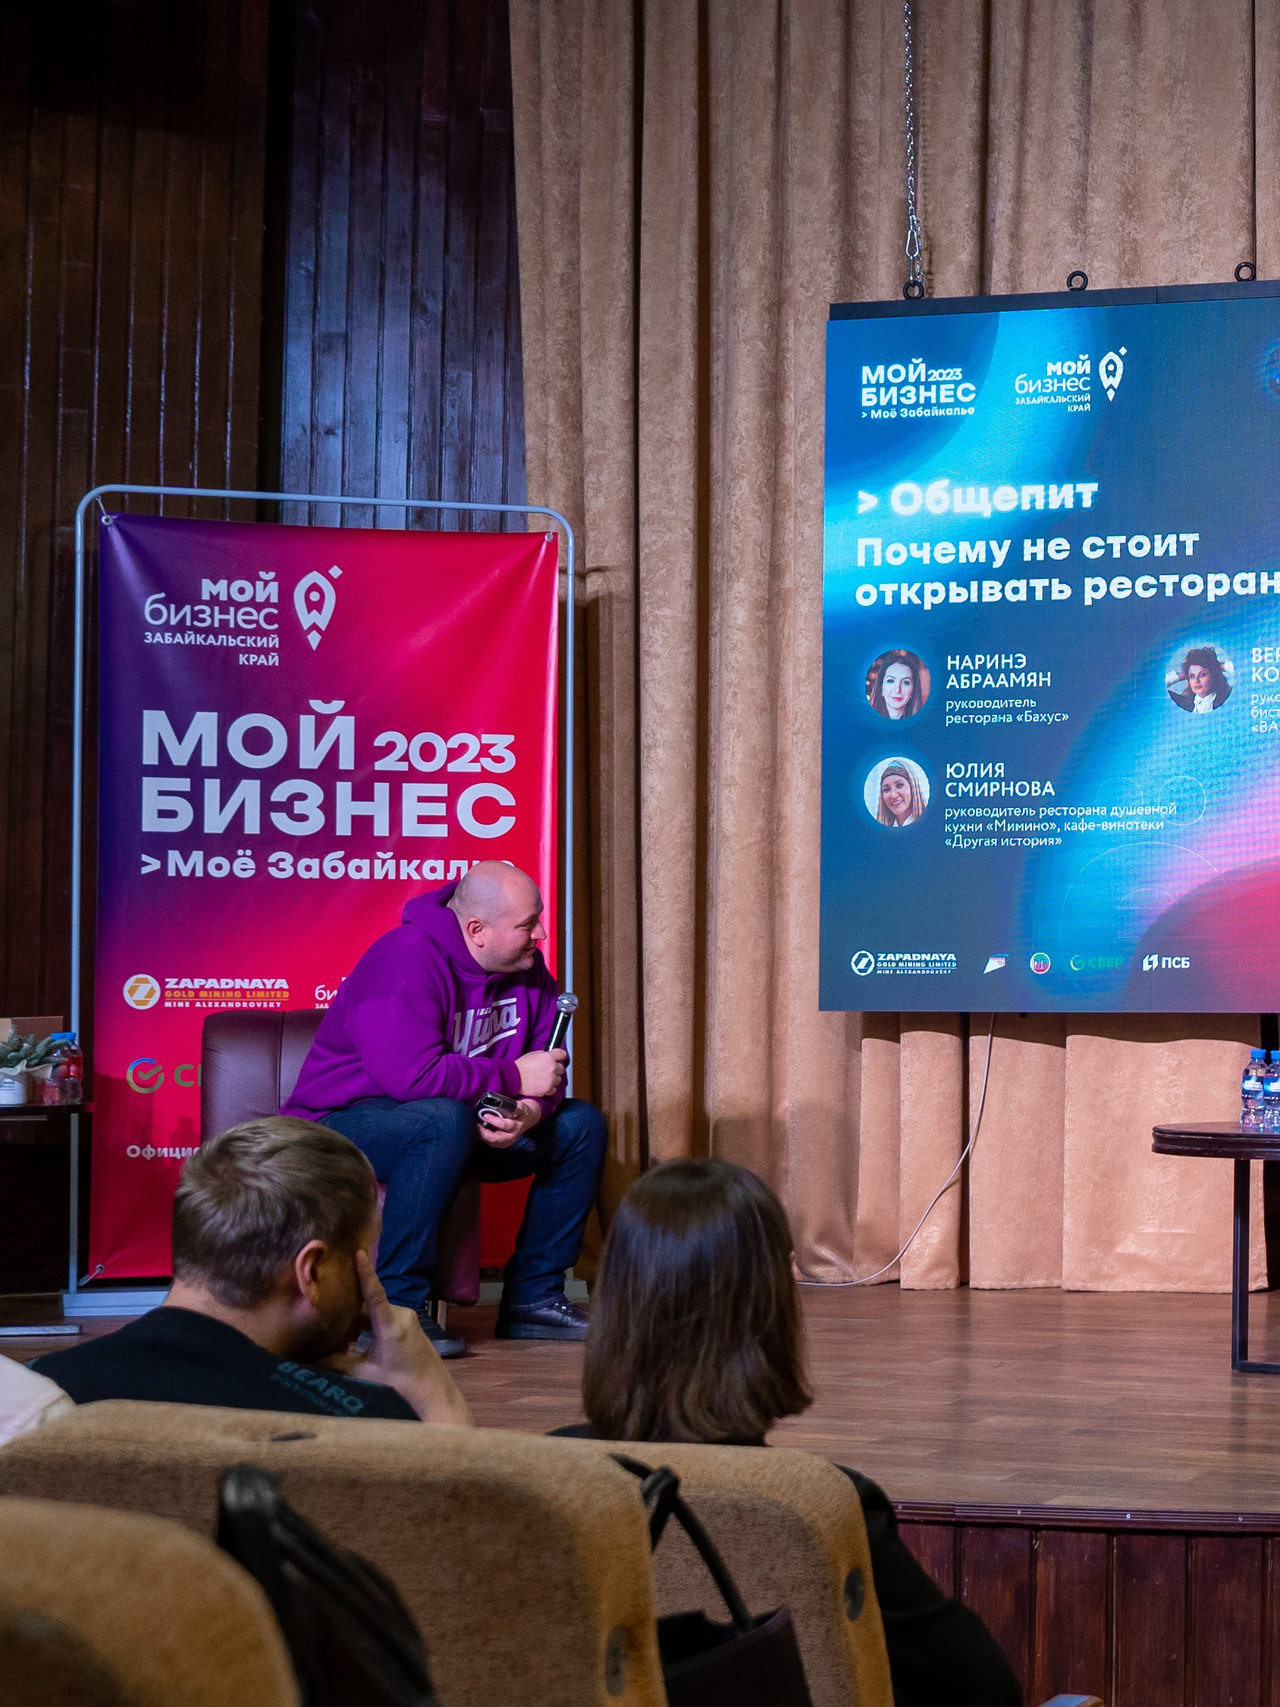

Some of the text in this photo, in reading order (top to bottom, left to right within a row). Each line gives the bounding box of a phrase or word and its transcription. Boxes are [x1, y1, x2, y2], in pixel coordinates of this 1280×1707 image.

[861, 358, 962, 384] МОЙ 2023
[1046, 354, 1091, 376] мой
[1015, 373, 1091, 394] бизнес
[861, 382, 976, 406] БИЗНЕС
[1015, 392, 1091, 405] ЗАБАЙКАЛЬСКИЙ
[871, 408, 897, 418] Моё
[900, 405, 975, 418] Забайкалье
[1067, 403, 1091, 412] КРАЙ
[890, 479, 1099, 518] Общепит
[857, 532, 1200, 568] Почему не стоит
[201, 571, 279, 603] мой
[855, 577, 1072, 611] открывать
[144, 592, 279, 630] бизнес
[144, 631, 279, 649] ЗАБАЙКАЛЬСКИЙ
[238, 650, 279, 666] КРАЙ
[947, 653, 1027, 671] НАРИНЭ
[946, 672, 1052, 689] АБРААМЯН
[945, 697, 1037, 712] руководитель
[945, 710, 1069, 726] ресторана «Бахус»
[142, 699, 516, 773] МОЙ 2023
[946, 762, 1005, 779] ЮЛИЯ
[945, 780, 1055, 798] СМИРНОВА
[141, 776, 516, 839] БИЗНЕС
[945, 803, 1177, 819] руководитель ресторана душевной
[945, 822, 983, 833] кухни
[1064, 819, 1164, 832] кафе-винотеки
[945, 834, 1062, 849] «Другая история»
[267, 850, 515, 881] Забайкал
[877, 953, 957, 961] ZAPADNAYA
[1161, 956, 1190, 969] ПСБ
[165, 978, 290, 989] ZAPADNAYA
